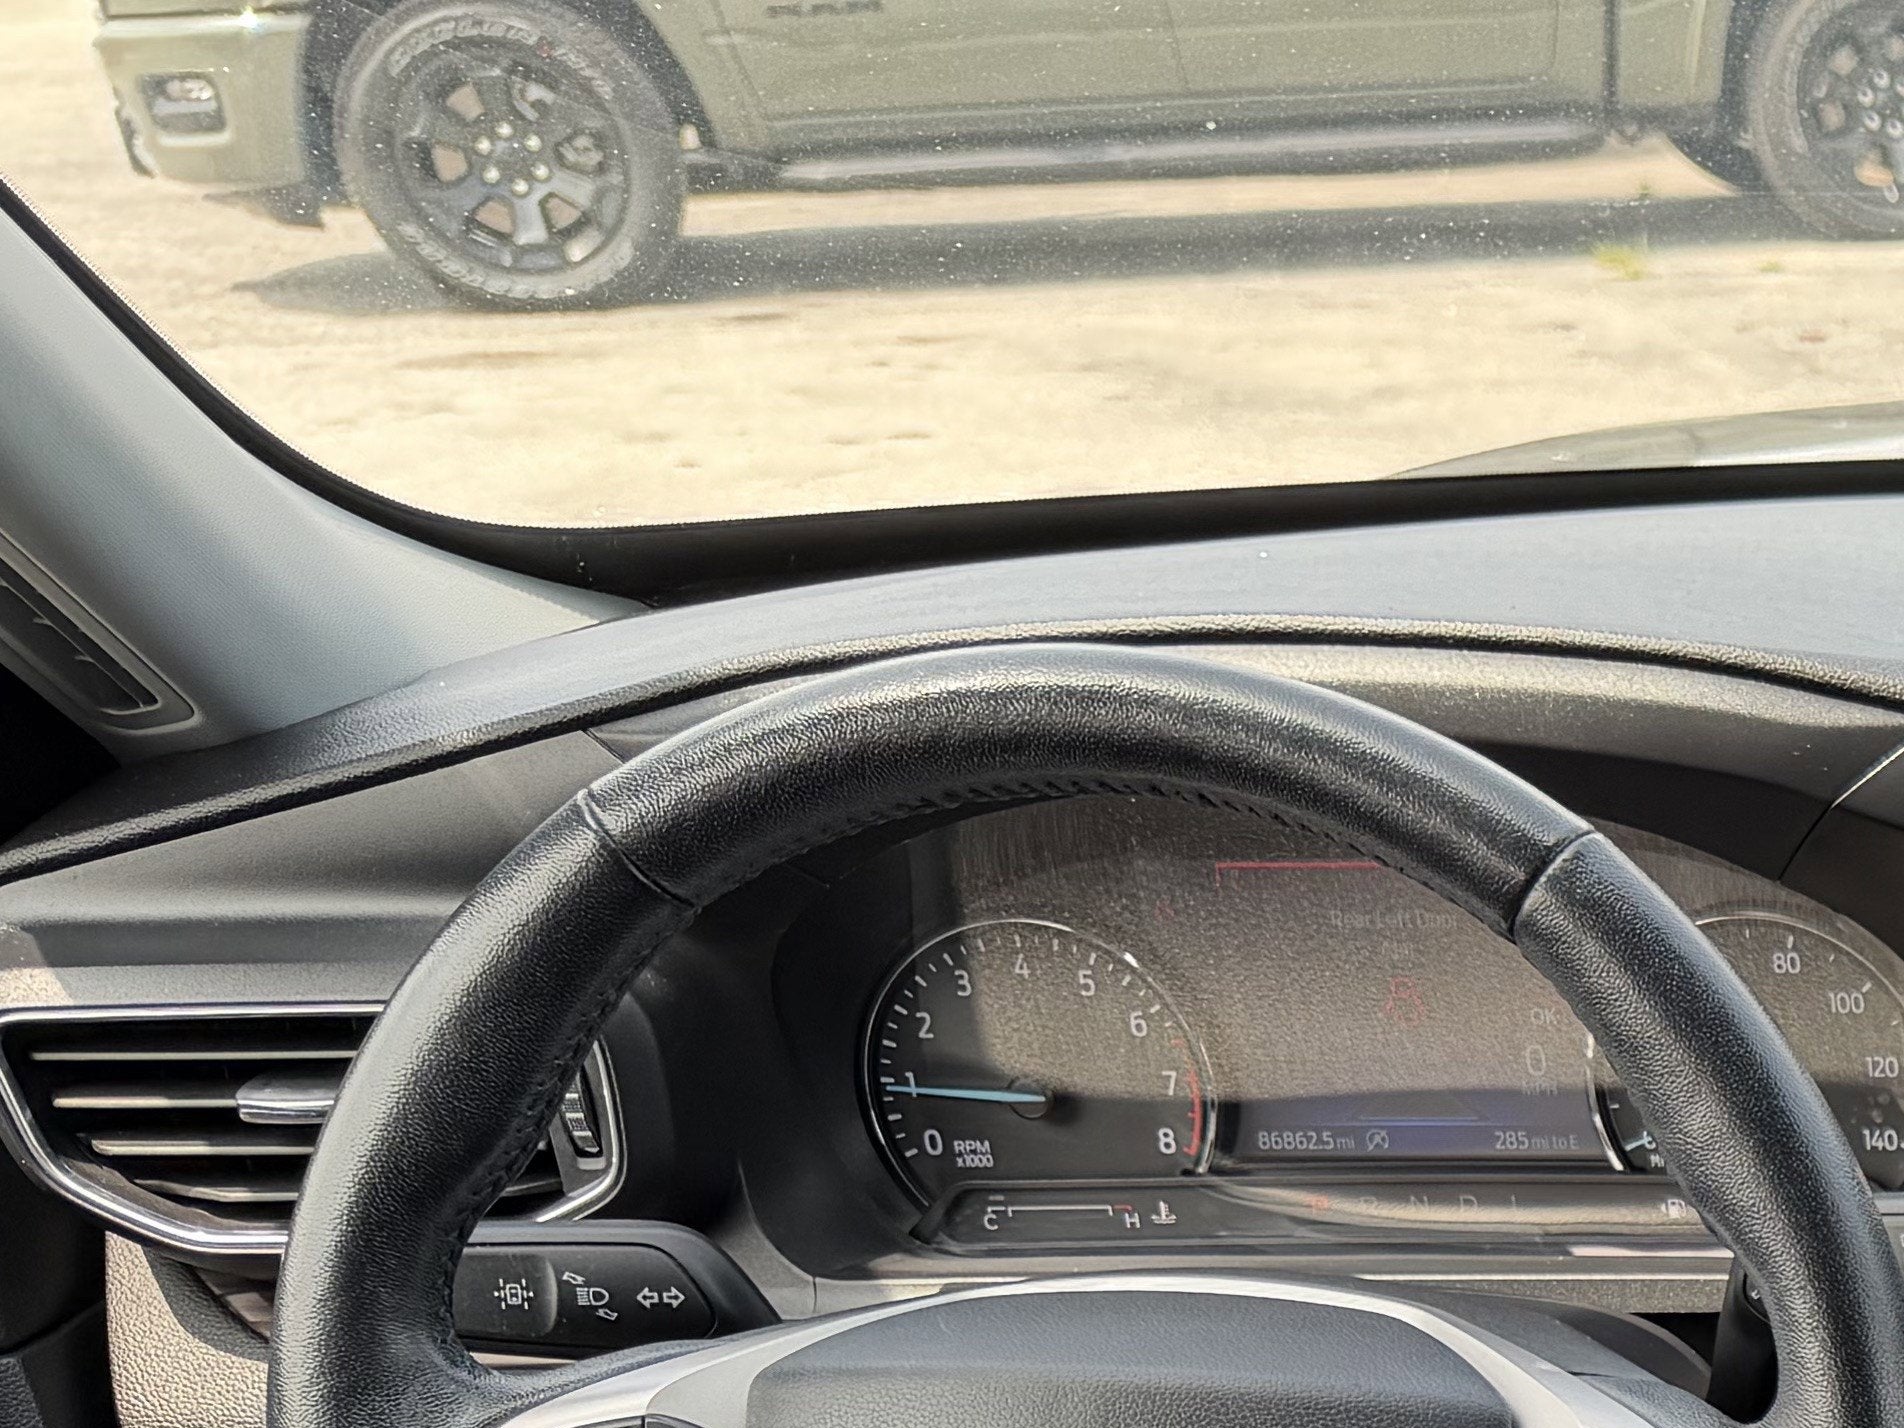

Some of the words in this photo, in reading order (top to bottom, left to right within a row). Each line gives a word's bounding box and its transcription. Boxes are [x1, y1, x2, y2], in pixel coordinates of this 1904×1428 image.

[1014, 952, 1031, 979] 4
[1772, 952, 1800, 974] 80
[954, 969, 973, 997] 3
[1077, 969, 1096, 997] 5
[1829, 991, 1865, 1015] 100
[915, 1011, 934, 1039] 2
[1129, 1011, 1148, 1038] 6
[1864, 1055, 1899, 1079] 120
[905, 1071, 918, 1098] 1
[1161, 1070, 1178, 1096] 7
[923, 1128, 944, 1156] 0
[953, 1139, 991, 1155] RPM
[1157, 1127, 1178, 1155] 8
[1257, 1131, 1334, 1151] 86862.5
[1494, 1130, 1530, 1150] 285
[1862, 1128, 1899, 1152] 140
[955, 1153, 994, 1168] x1000
[983, 1214, 999, 1231] C
[1125, 1212, 1141, 1229] H
